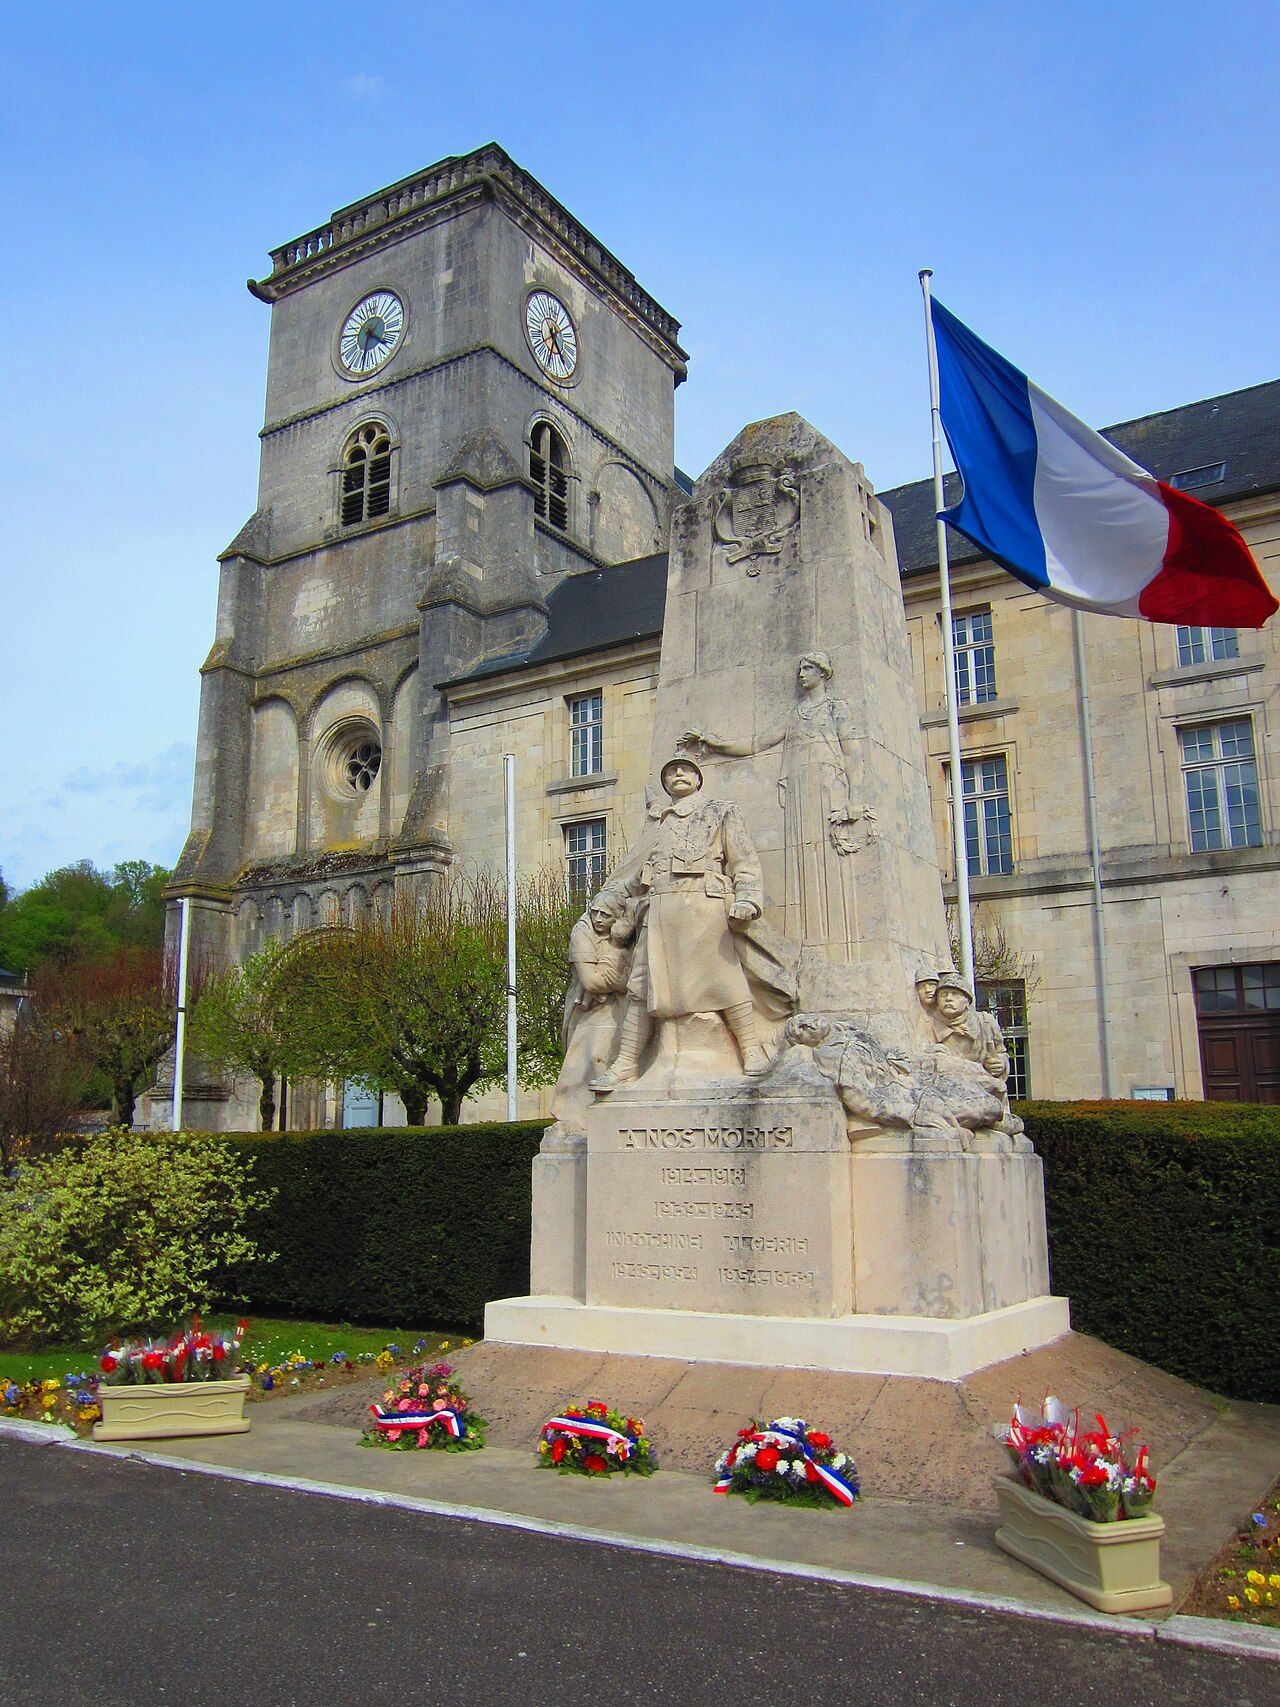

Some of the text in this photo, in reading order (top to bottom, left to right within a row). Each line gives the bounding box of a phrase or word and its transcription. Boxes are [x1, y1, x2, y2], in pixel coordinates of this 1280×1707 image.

[624, 1126, 792, 1148] A NOS MORTS
[607, 1231, 703, 1251] INDOCHINE
[724, 1235, 809, 1255] ALGERIE
